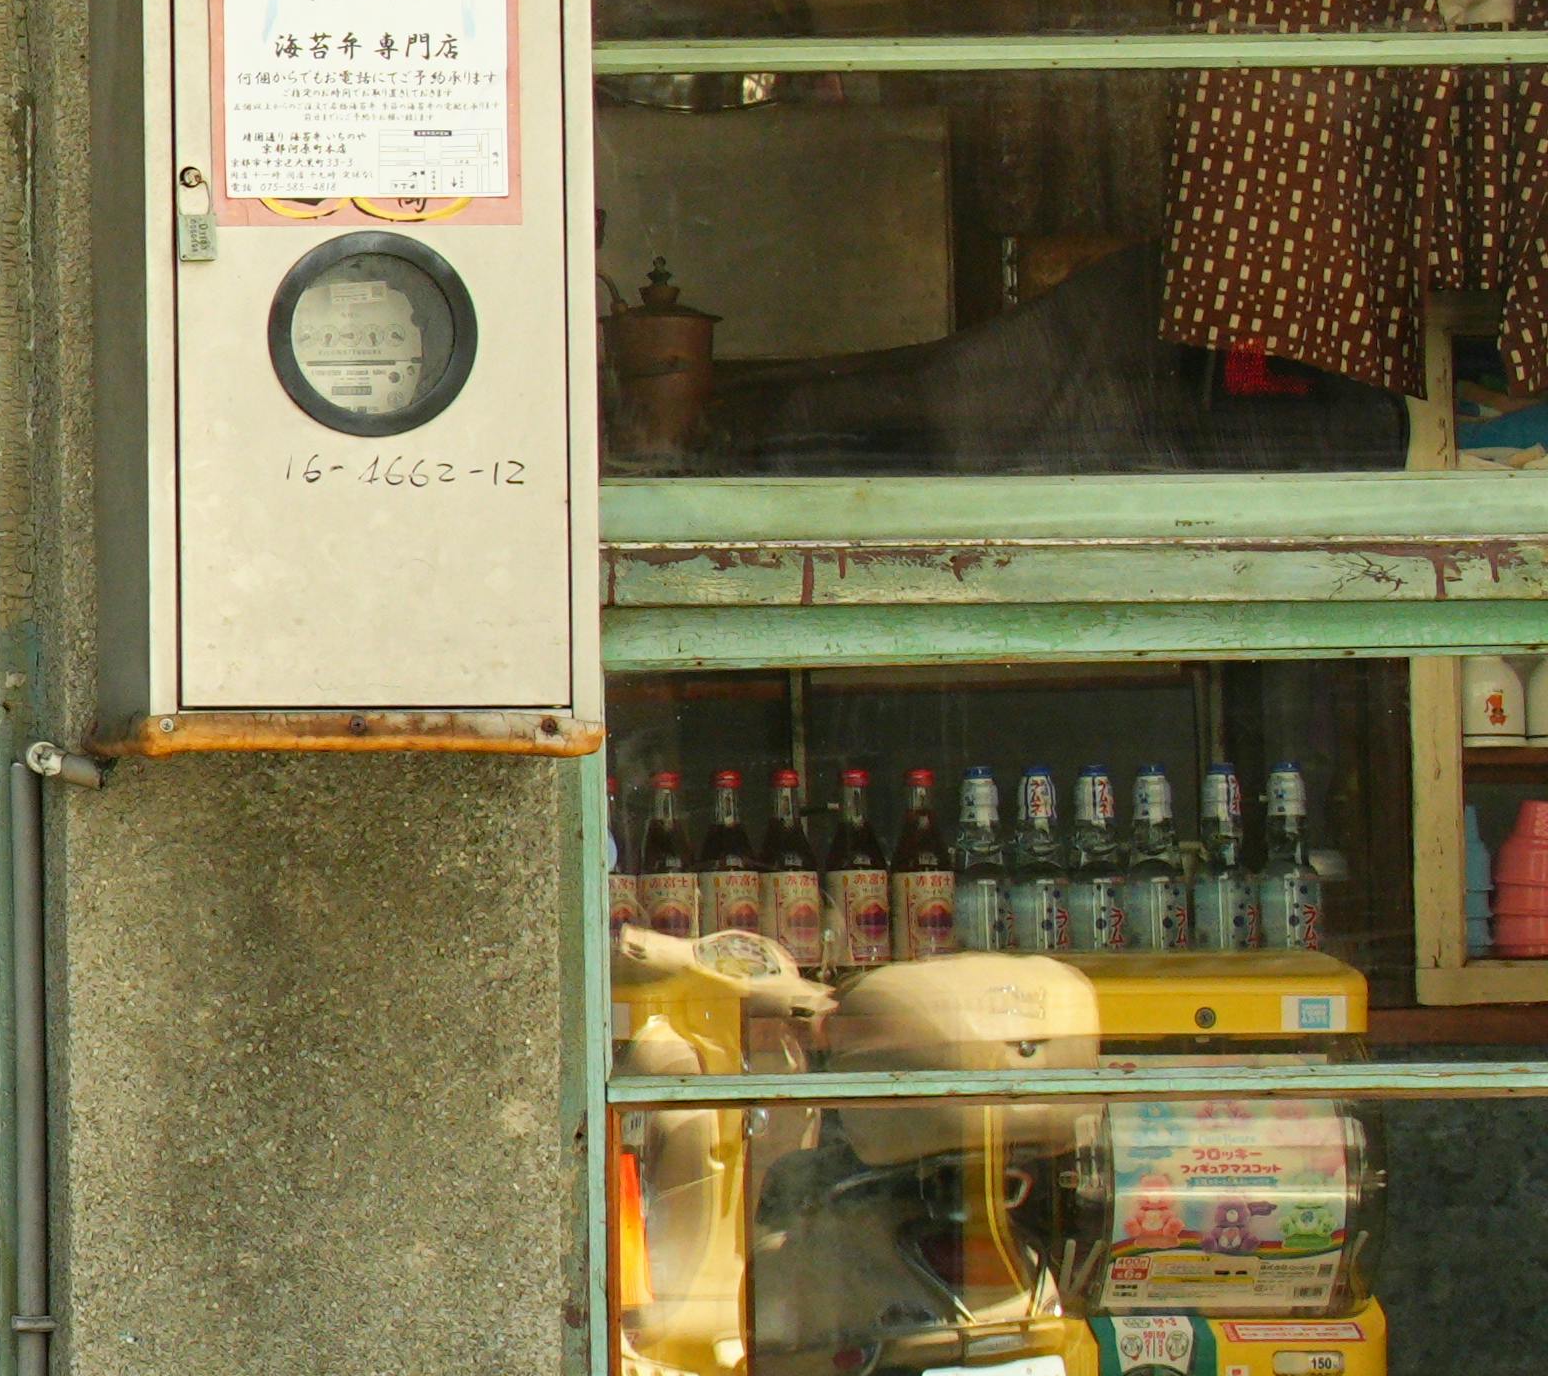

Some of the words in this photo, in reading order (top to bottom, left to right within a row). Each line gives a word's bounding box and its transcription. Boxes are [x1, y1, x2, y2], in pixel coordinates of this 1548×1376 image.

[274, 32, 363, 60] 海苔弁
[373, 32, 460, 60] 専門店
[649, 875, 690, 890] 赤富士
[1311, 1357, 1332, 1370] 150
